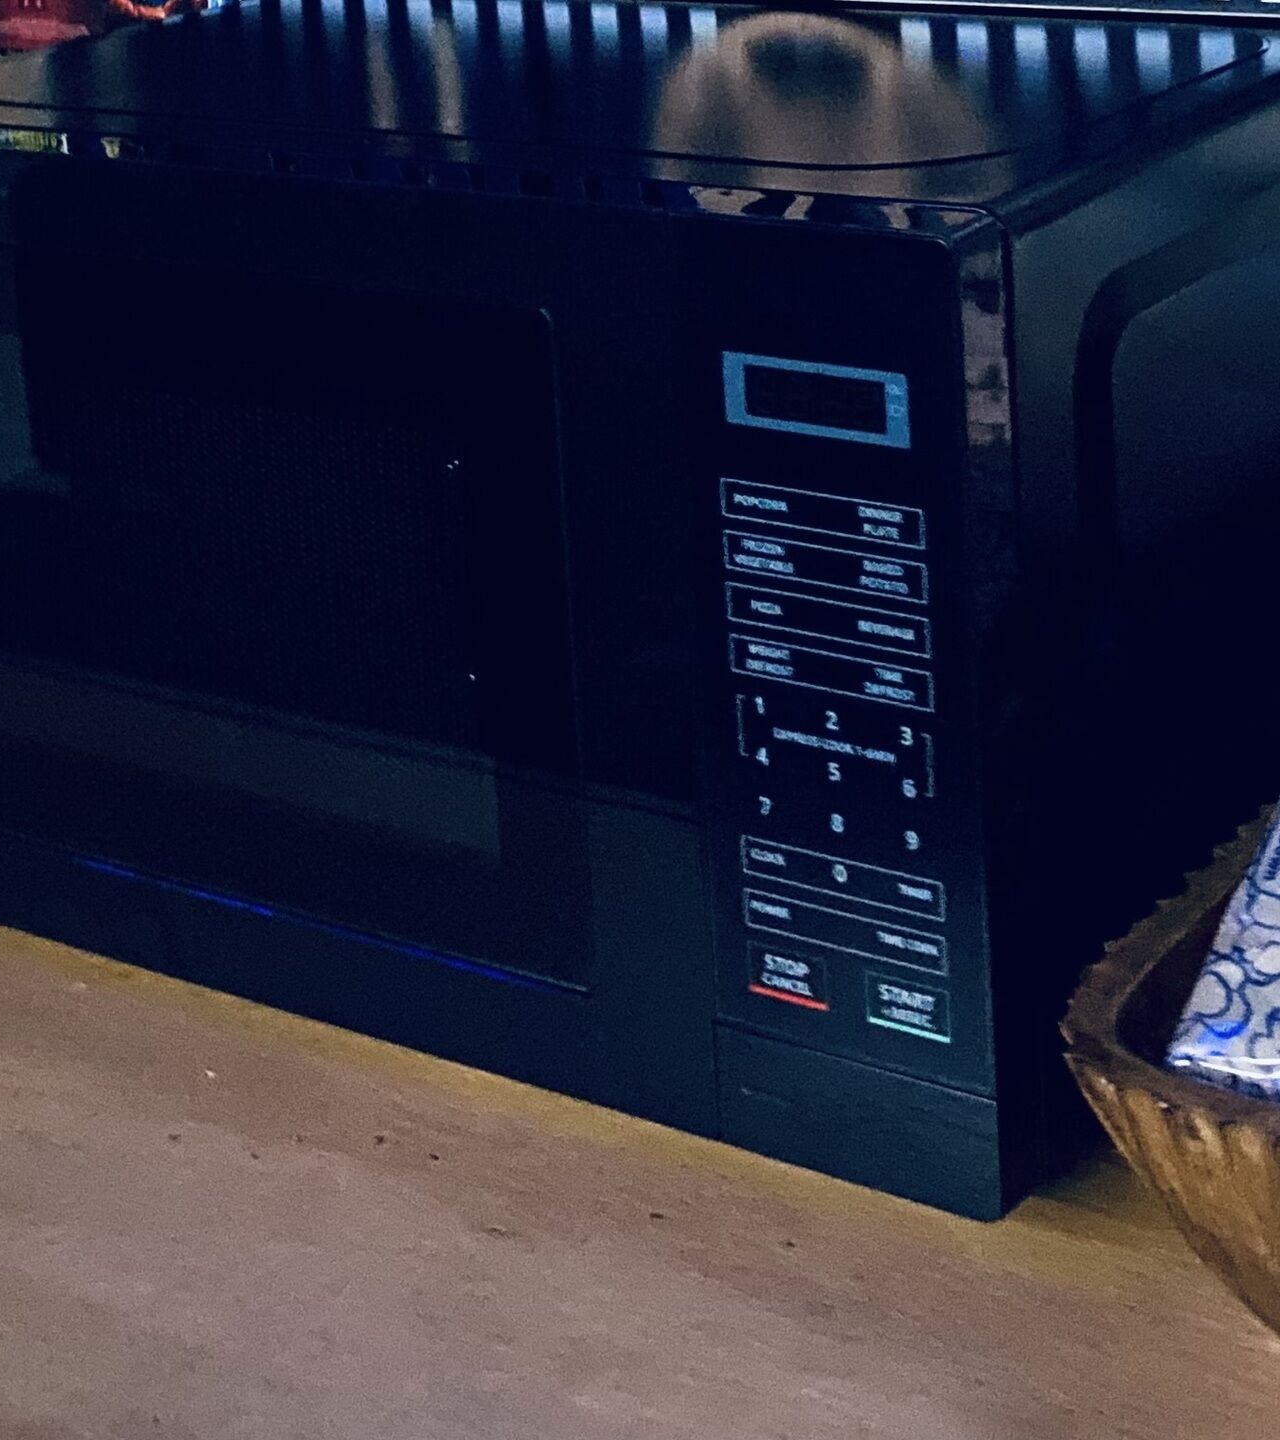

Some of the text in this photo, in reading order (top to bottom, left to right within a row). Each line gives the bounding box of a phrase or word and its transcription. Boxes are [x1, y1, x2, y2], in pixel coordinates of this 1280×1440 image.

[825, 711, 839, 731] 2
[900, 726, 914, 746] 3
[756, 748, 769, 766] 4
[828, 762, 842, 782] 5
[902, 778, 917, 799] 6
[759, 796, 771, 816] 7
[830, 813, 845, 834] 8
[904, 831, 919, 850] 9
